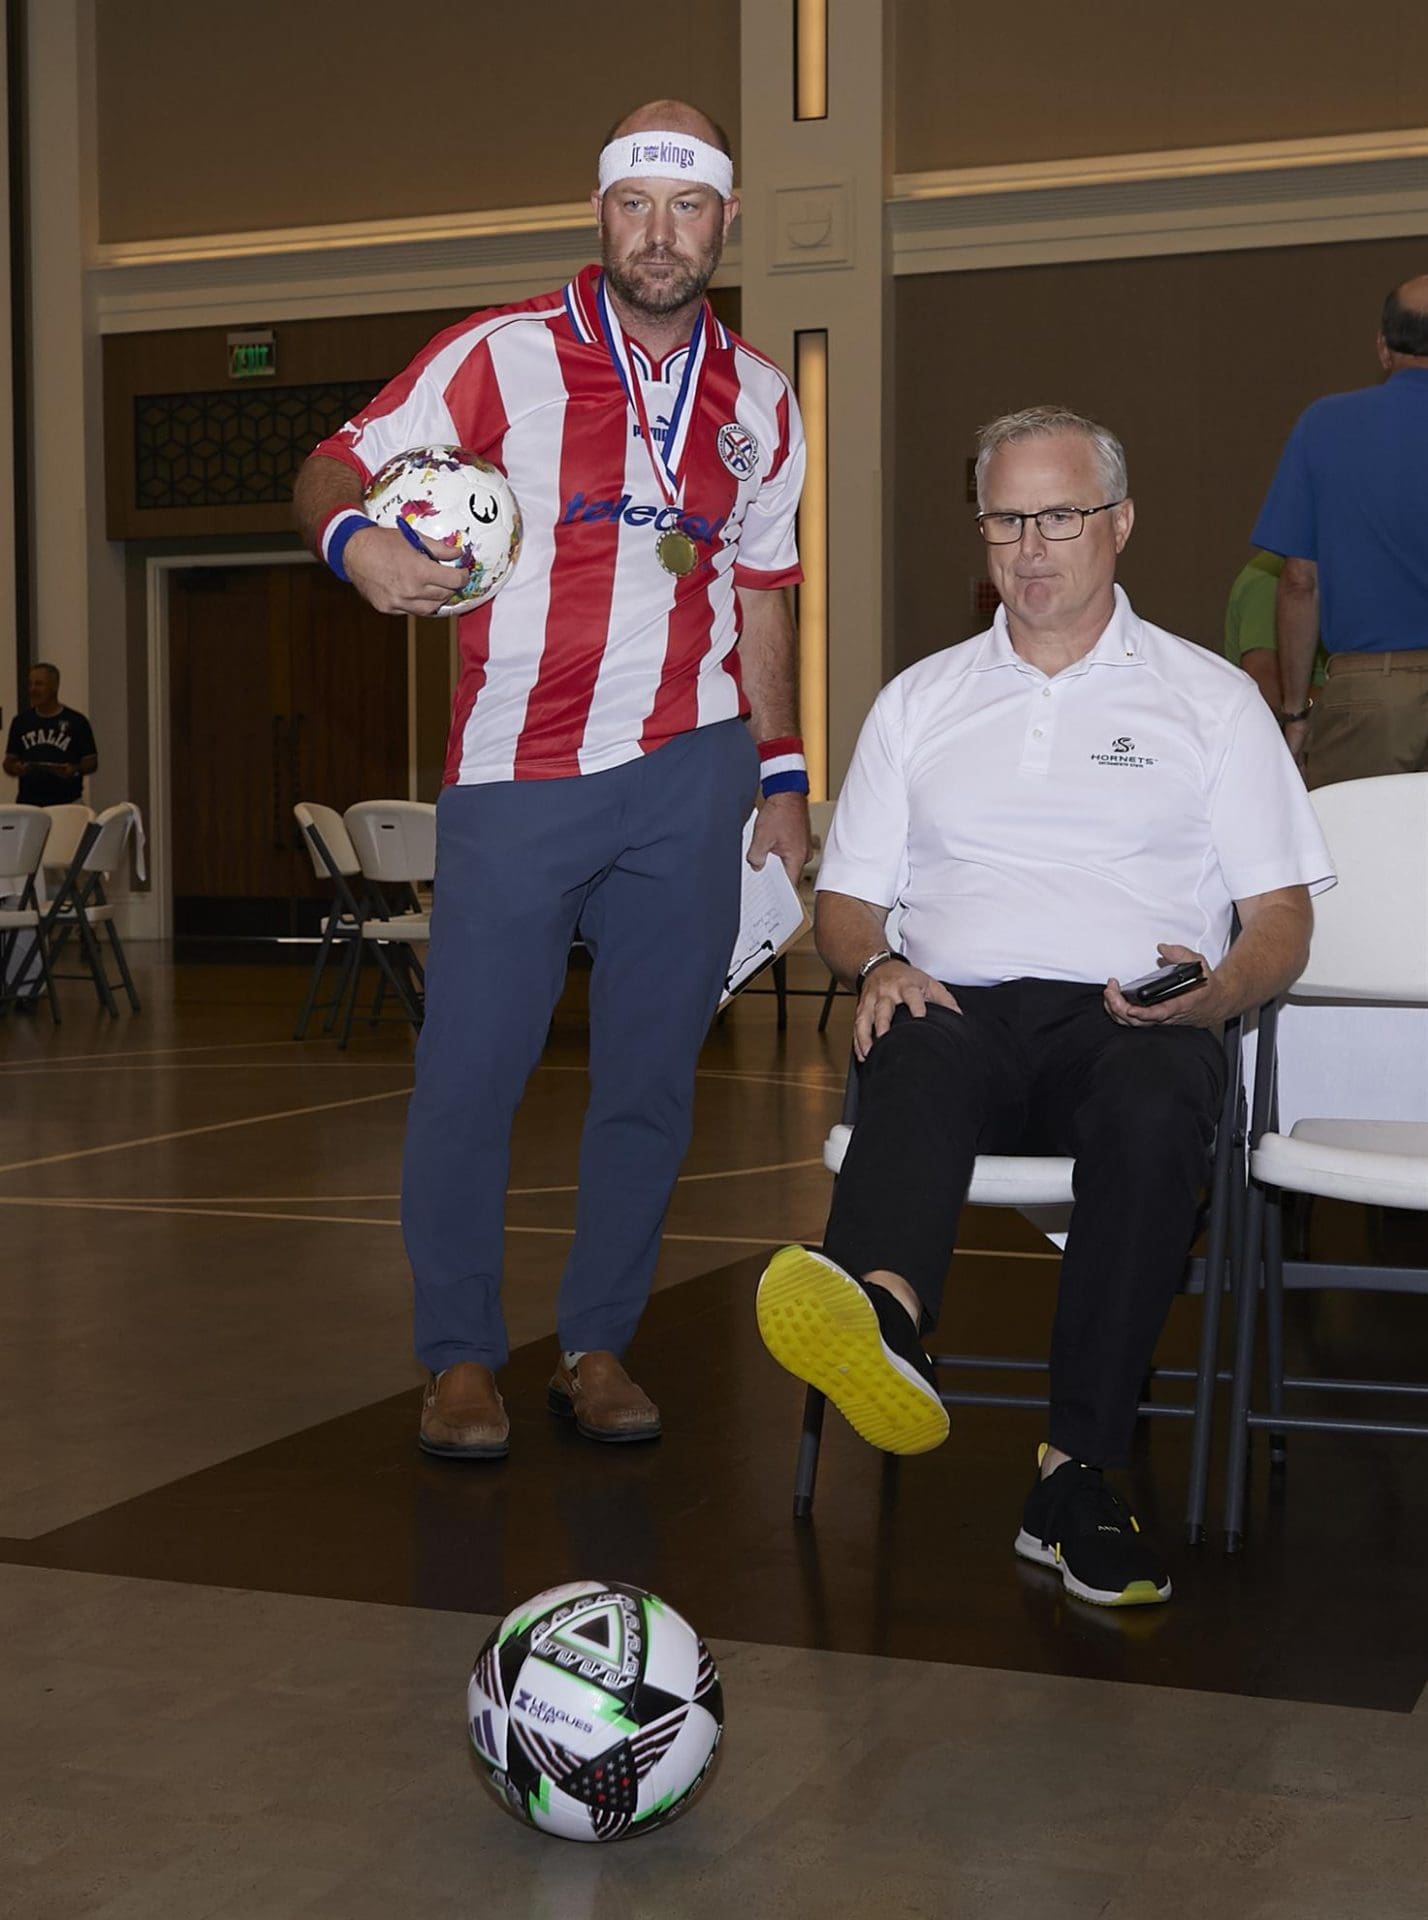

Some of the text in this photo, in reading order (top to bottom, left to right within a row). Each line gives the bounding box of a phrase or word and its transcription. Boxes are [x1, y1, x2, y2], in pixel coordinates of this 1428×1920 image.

[630, 142, 694, 168] jr. kings
[21, 728, 72, 752] ITALIA
[1091, 754, 1154, 765] HORNETS
[528, 1704, 556, 1724] CUP
[532, 1696, 593, 1733] LEAGUES
